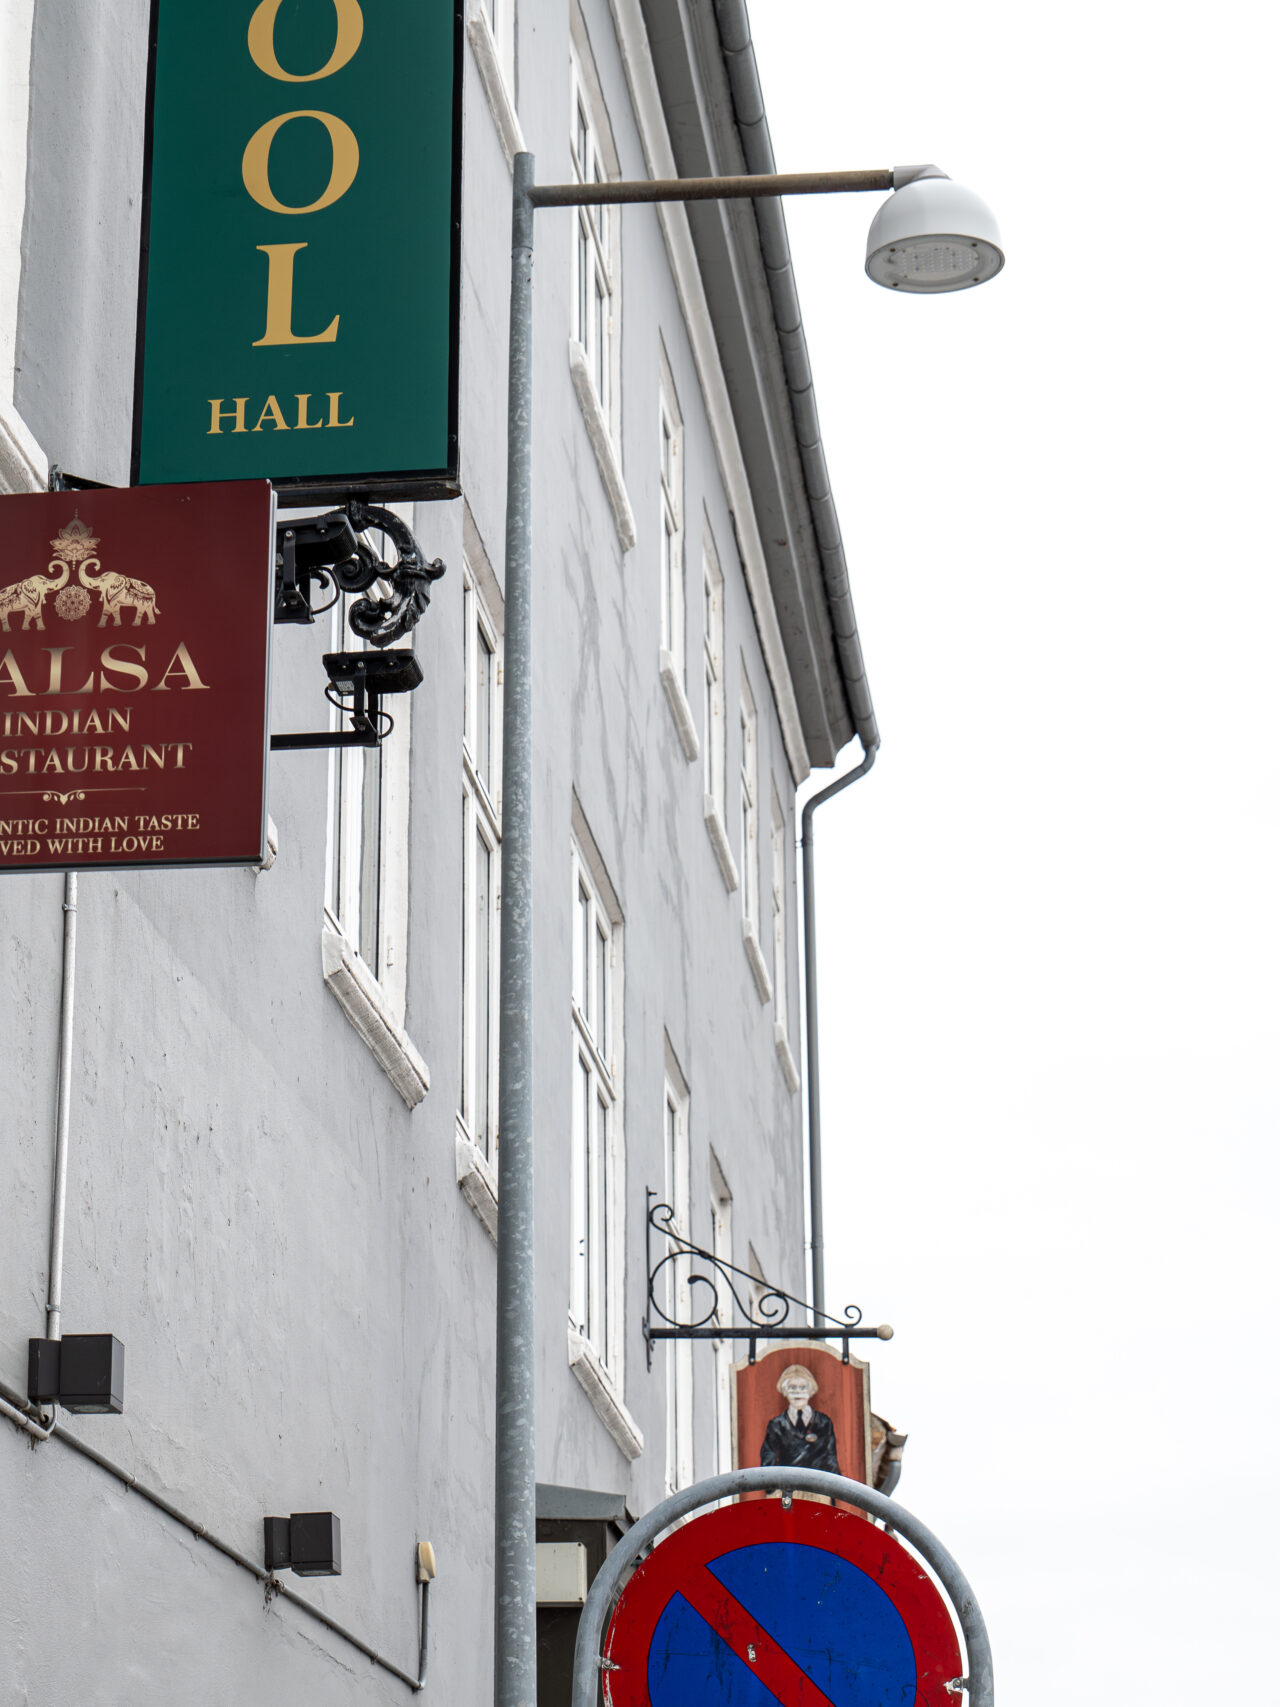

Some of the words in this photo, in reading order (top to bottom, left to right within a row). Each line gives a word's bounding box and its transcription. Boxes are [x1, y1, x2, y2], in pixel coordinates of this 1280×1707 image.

[206, 392, 355, 434] HALL
[2, 707, 133, 737] INDIAN
[55, 815, 129, 834] INDIAN
[135, 814, 201, 831] TASTE
[47, 837, 102, 854] WITH
[110, 835, 164, 852] LOVE
